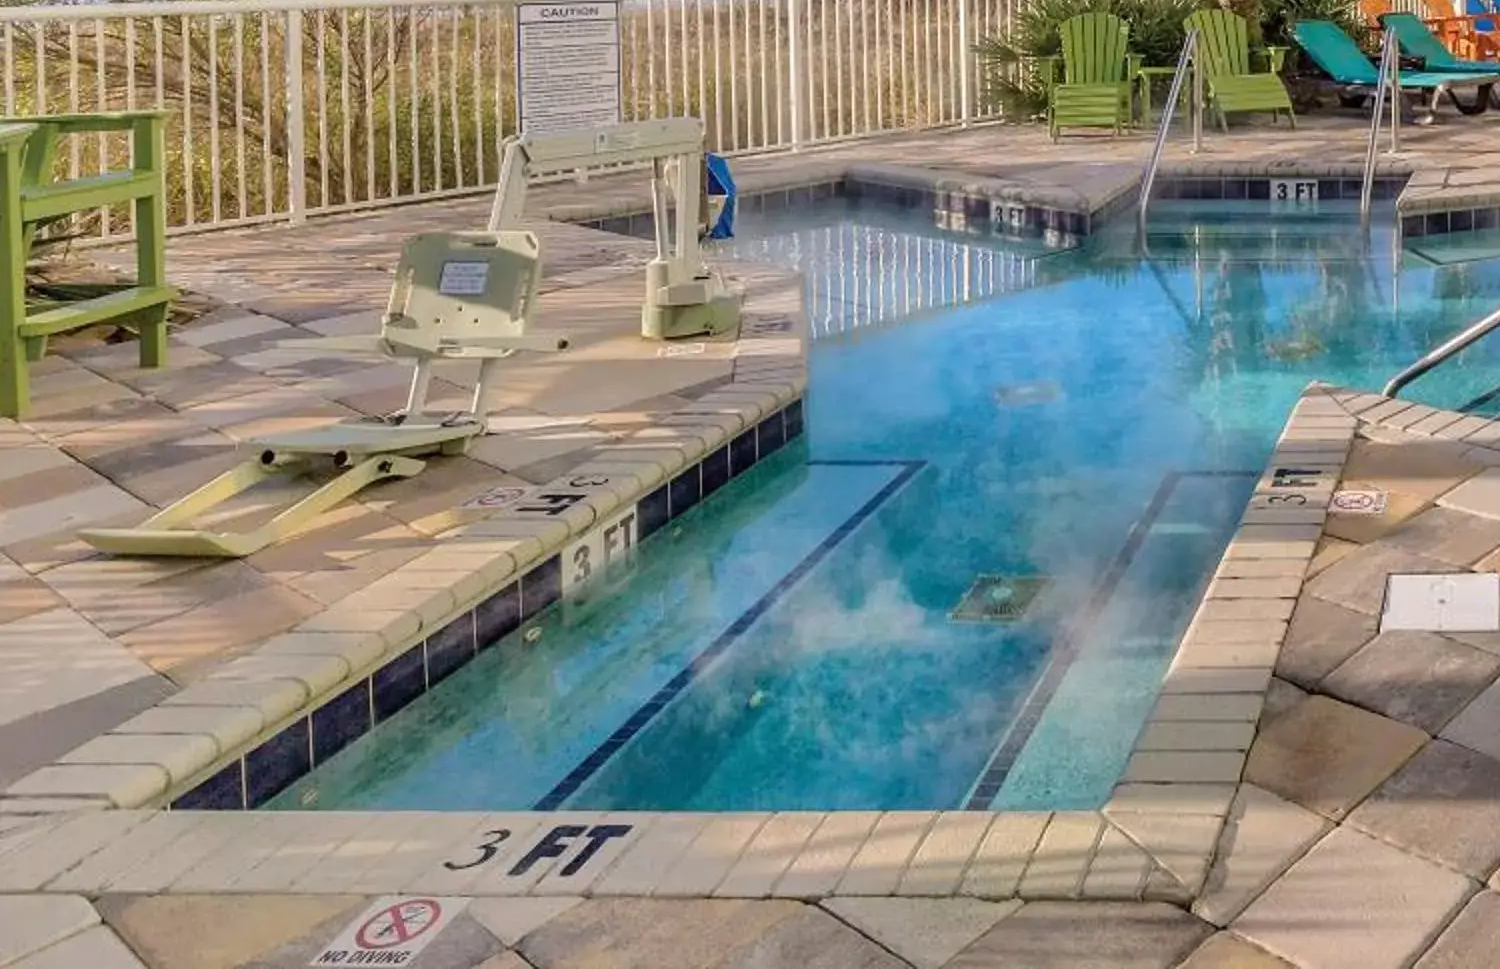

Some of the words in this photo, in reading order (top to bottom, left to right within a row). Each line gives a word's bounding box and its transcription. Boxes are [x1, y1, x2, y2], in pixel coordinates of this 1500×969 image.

[540, 6, 599, 18] CAUTION
[1277, 182, 1288, 200] 3
[1295, 182, 1316, 201] FT
[1270, 468, 1322, 488] FT
[515, 493, 588, 516] FT
[1268, 494, 1307, 505] 3
[573, 544, 592, 582] 3
[603, 512, 635, 578] FT
[444, 829, 511, 870] 3
[507, 824, 633, 876] FT
[318, 950, 348, 964] NO
[346, 950, 412, 964] DIVING
